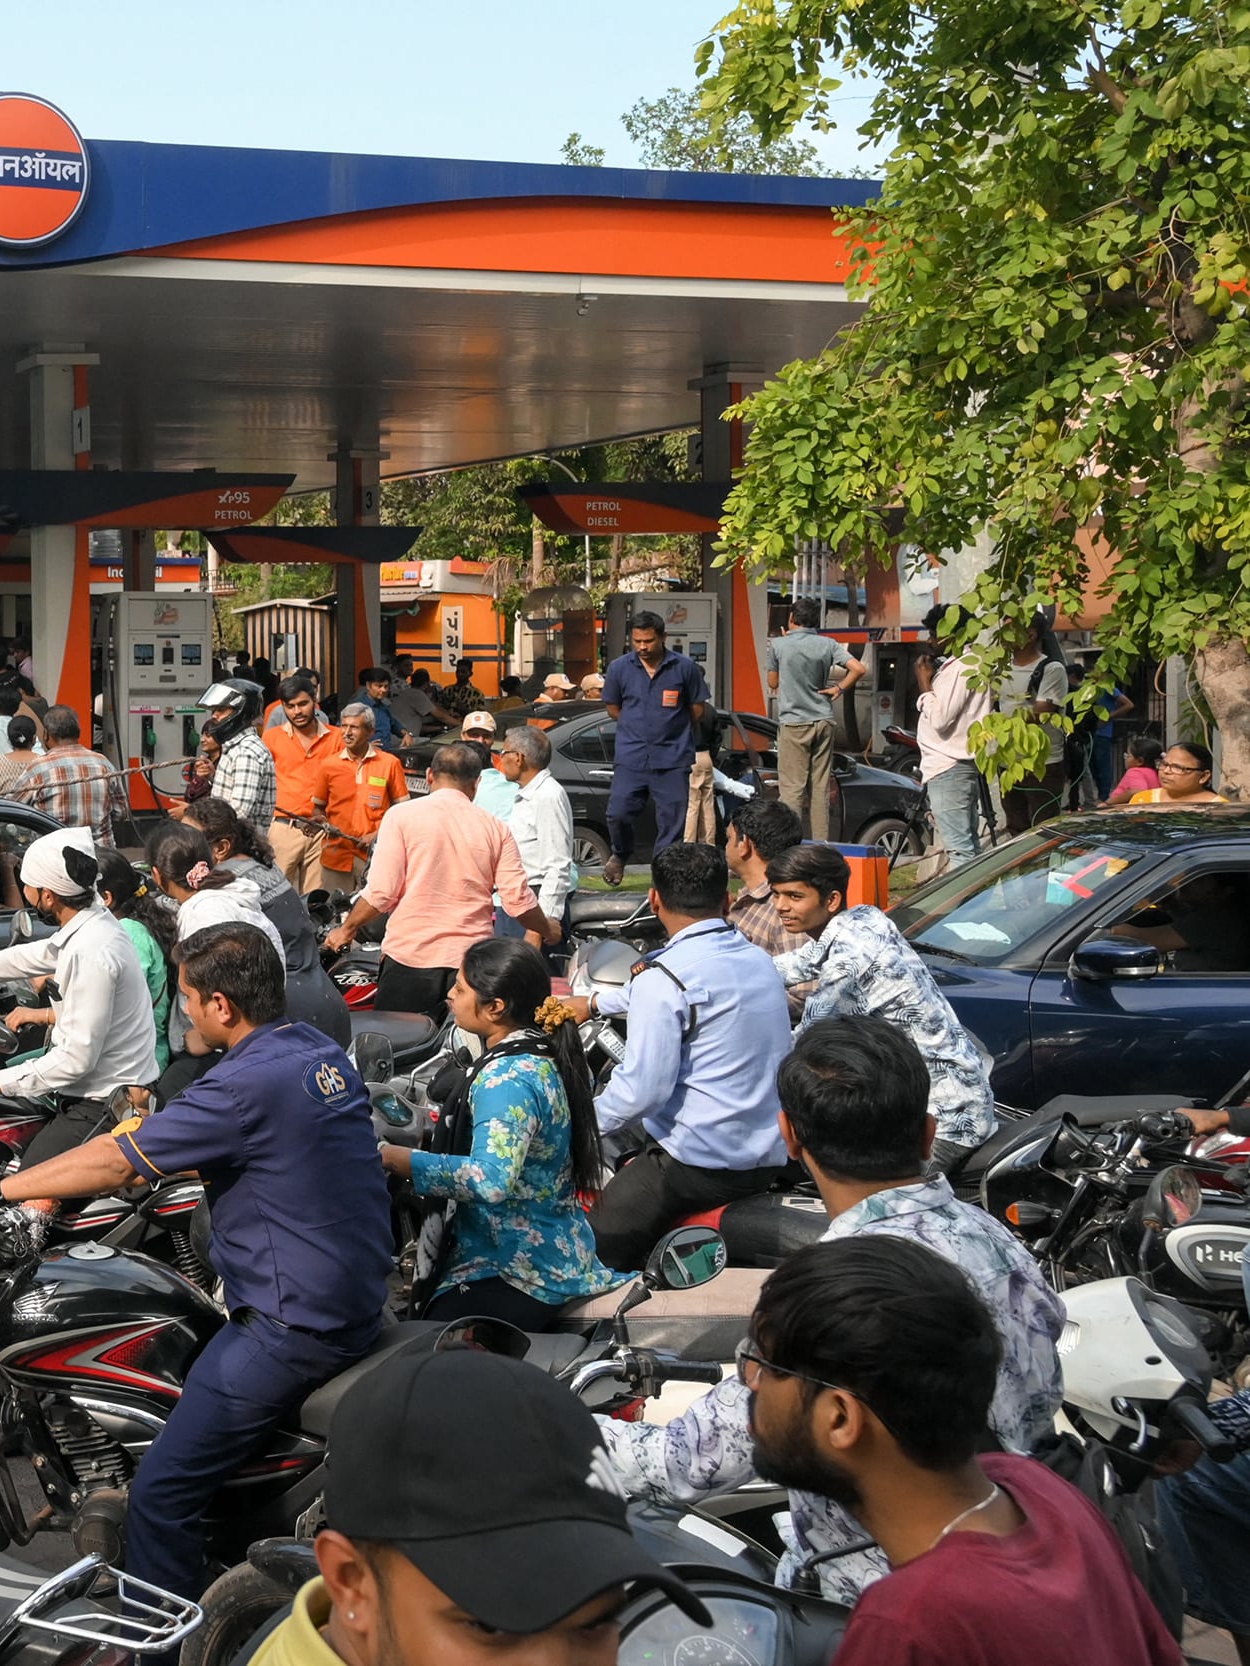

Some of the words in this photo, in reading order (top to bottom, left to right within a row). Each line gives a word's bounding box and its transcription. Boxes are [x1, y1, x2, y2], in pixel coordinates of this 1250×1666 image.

[77, 417, 83, 444] 1
[365, 490, 373, 509] 3
[586, 501, 622, 511] PETROL
[214, 510, 253, 520] PETROL
[587, 517, 619, 526] DIESEL
